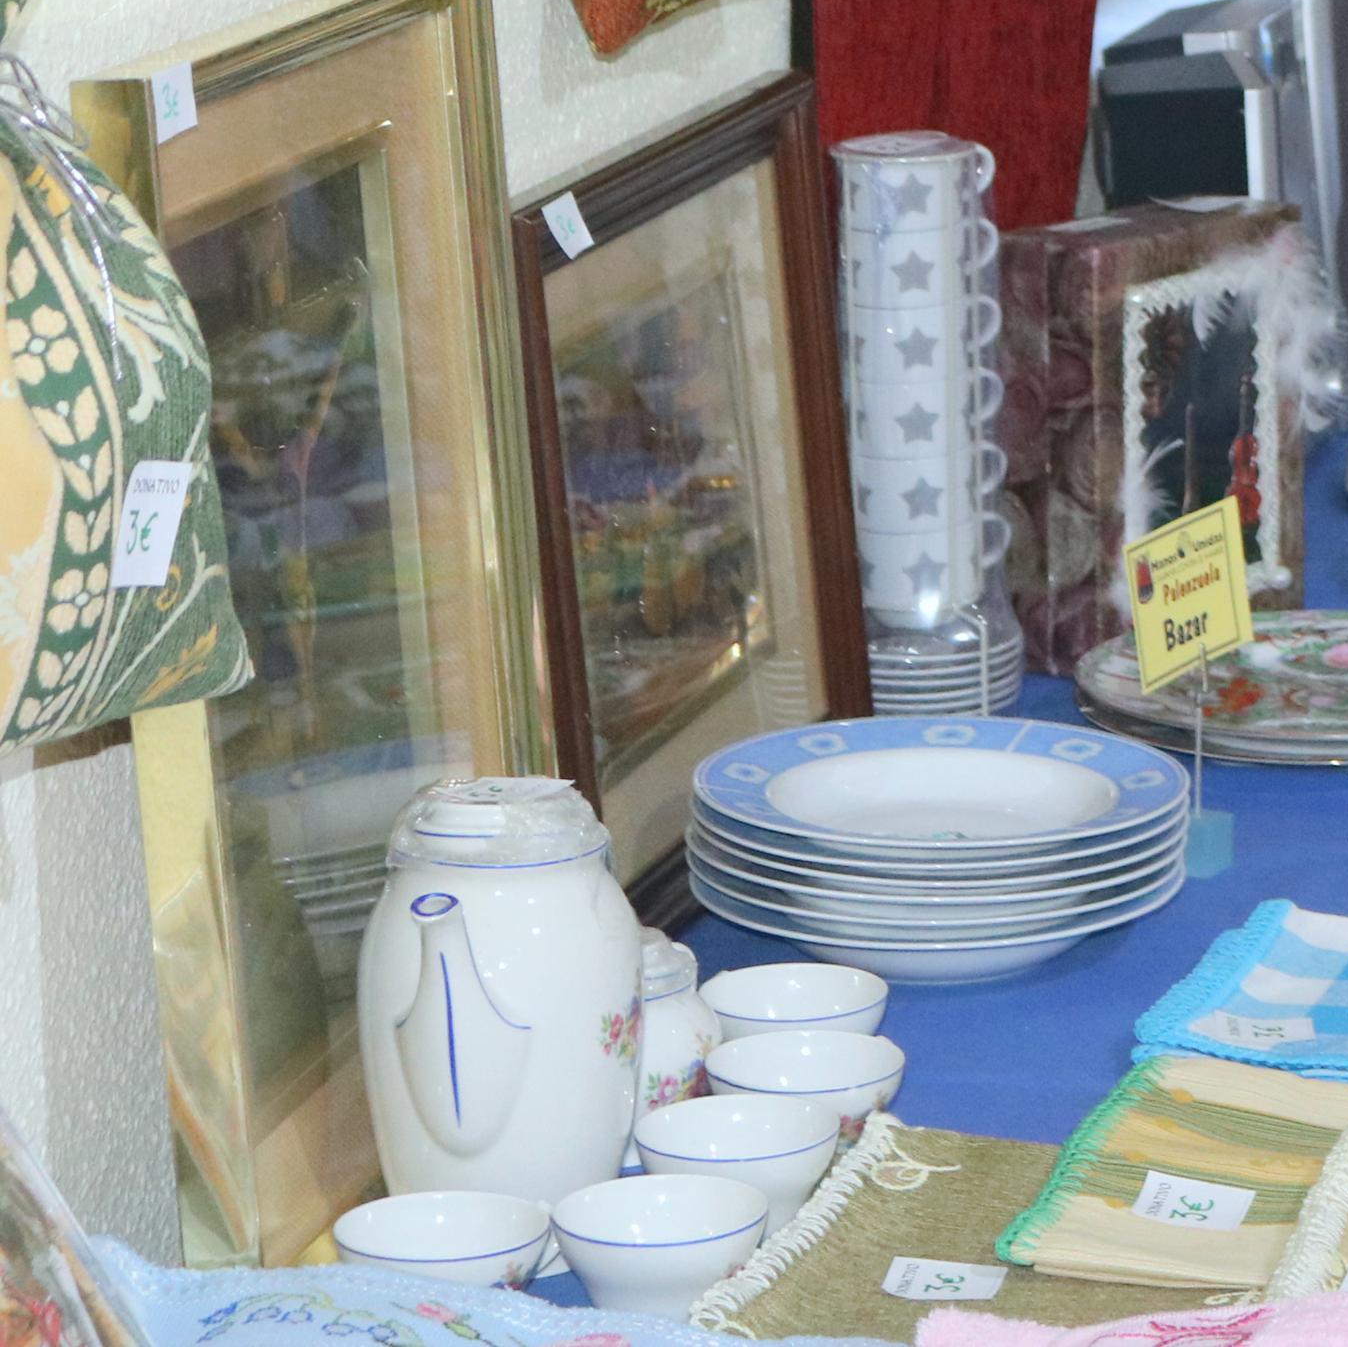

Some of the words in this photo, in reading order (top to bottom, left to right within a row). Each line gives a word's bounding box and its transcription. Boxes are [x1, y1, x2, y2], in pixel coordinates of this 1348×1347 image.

[134, 478, 180, 494] DONATIVO
[126, 509, 159, 555] 3€
[1162, 562, 1221, 606] Palenzuela
[1163, 611, 1209, 653] Bazar
[1252, 1024, 1285, 1038] 3€
[1168, 1195, 1214, 1221] 3€
[924, 1272, 965, 1293] 3€
